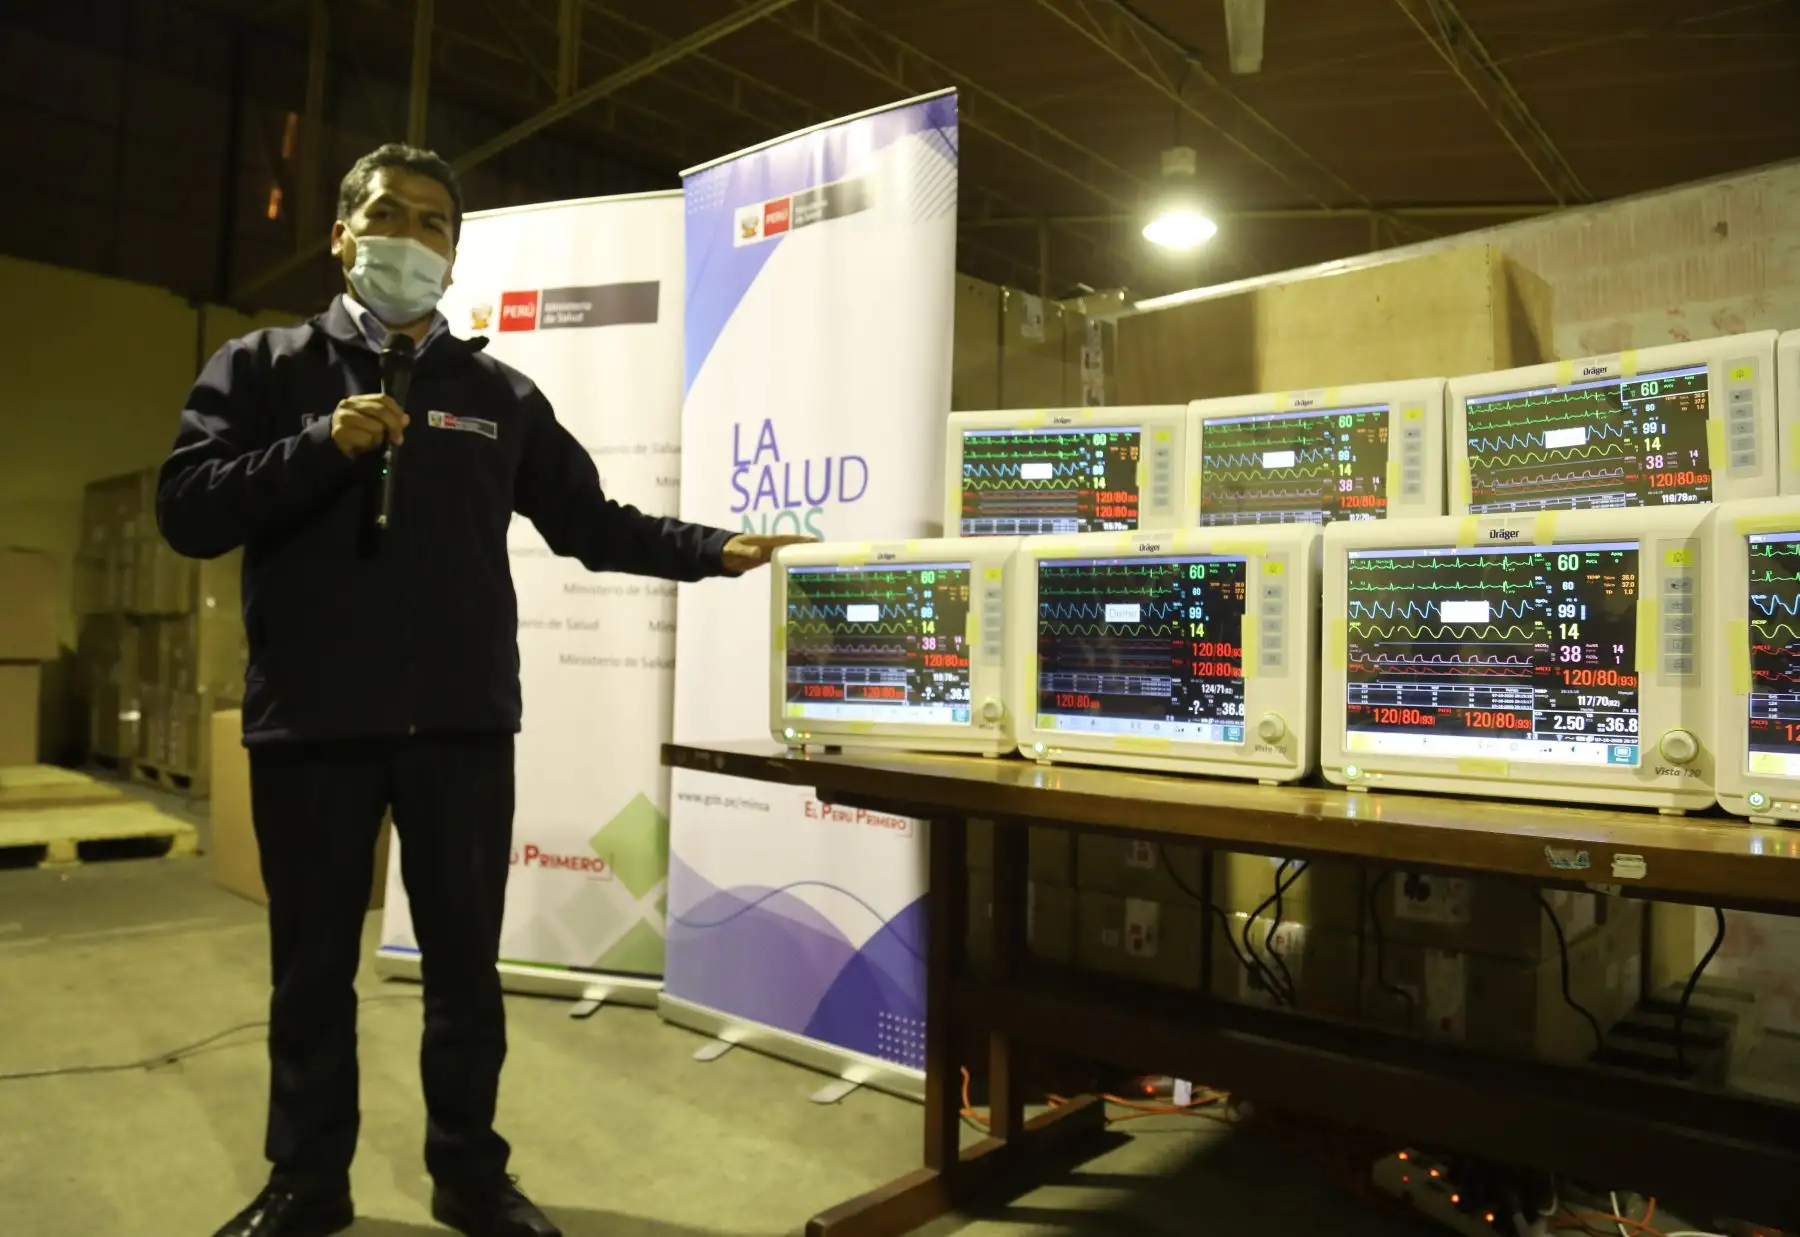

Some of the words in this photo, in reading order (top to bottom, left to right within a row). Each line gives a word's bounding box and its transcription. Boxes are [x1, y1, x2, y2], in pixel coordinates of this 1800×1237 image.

[503, 303, 535, 318] PERÚ
[1584, 367, 1608, 375] Dräger
[1641, 381, 1658, 396] 60
[1339, 415, 1352, 428] 60
[1642, 422, 1657, 434] 99
[733, 418, 780, 467] LA
[1644, 437, 1661, 452] 14
[1646, 455, 1663, 469] 38
[1689, 450, 1699, 458] 14
[1339, 463, 1352, 476] 14
[730, 455, 868, 513] SALUD
[1093, 477, 1106, 489] 14
[1339, 480, 1352, 491] 38
[1490, 529, 1520, 540] Dräger
[1557, 554, 1579, 571] 60
[921, 570, 935, 584] 60
[1189, 564, 1205, 579] 60
[563, 583, 623, 596] Ministerio
[626, 584, 640, 595] de
[1189, 607, 1202, 619] 99
[1558, 604, 1576, 618] 99
[566, 618, 599, 630] Salud
[922, 620, 935, 634] 14
[1189, 623, 1204, 637] 14
[1559, 623, 1579, 640] 14
[922, 637, 936, 650] 38
[1560, 645, 1581, 662] 38
[1612, 644, 1624, 653] 14
[1616, 656, 1620, 664] 1
[559, 654, 621, 667] Ministerio
[1563, 669, 1637, 687] 120/80(93)
[1554, 715, 1585, 730] 2.50
[1605, 717, 1638, 732] 36.8
[1655, 766, 1680, 776] Vista
[1685, 768, 1701, 777] 120
[524, 844, 605, 873] PRIMERO
